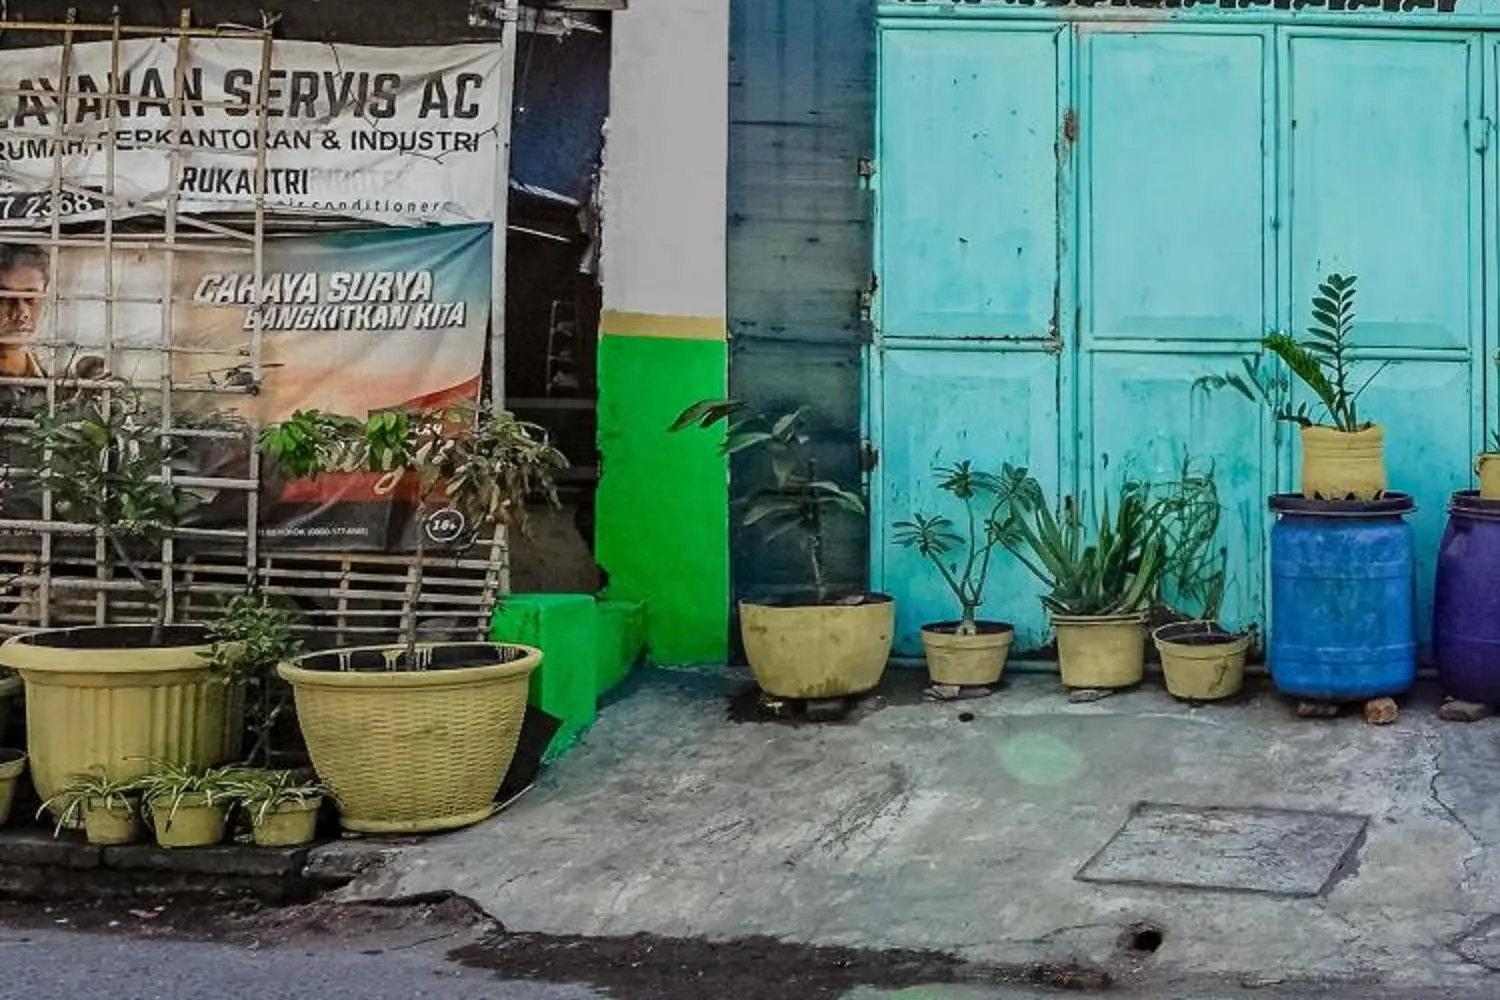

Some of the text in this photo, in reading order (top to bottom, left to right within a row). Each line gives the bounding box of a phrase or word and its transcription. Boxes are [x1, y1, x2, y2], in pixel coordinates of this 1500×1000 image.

[223, 68, 401, 119] SERVIS
[417, 71, 484, 119] AC
[321, 129, 341, 150] &
[351, 130, 479, 152] INDUSTRI
[328, 270, 435, 302] SURYA
[243, 300, 467, 330] BANGKITKAN KITA
